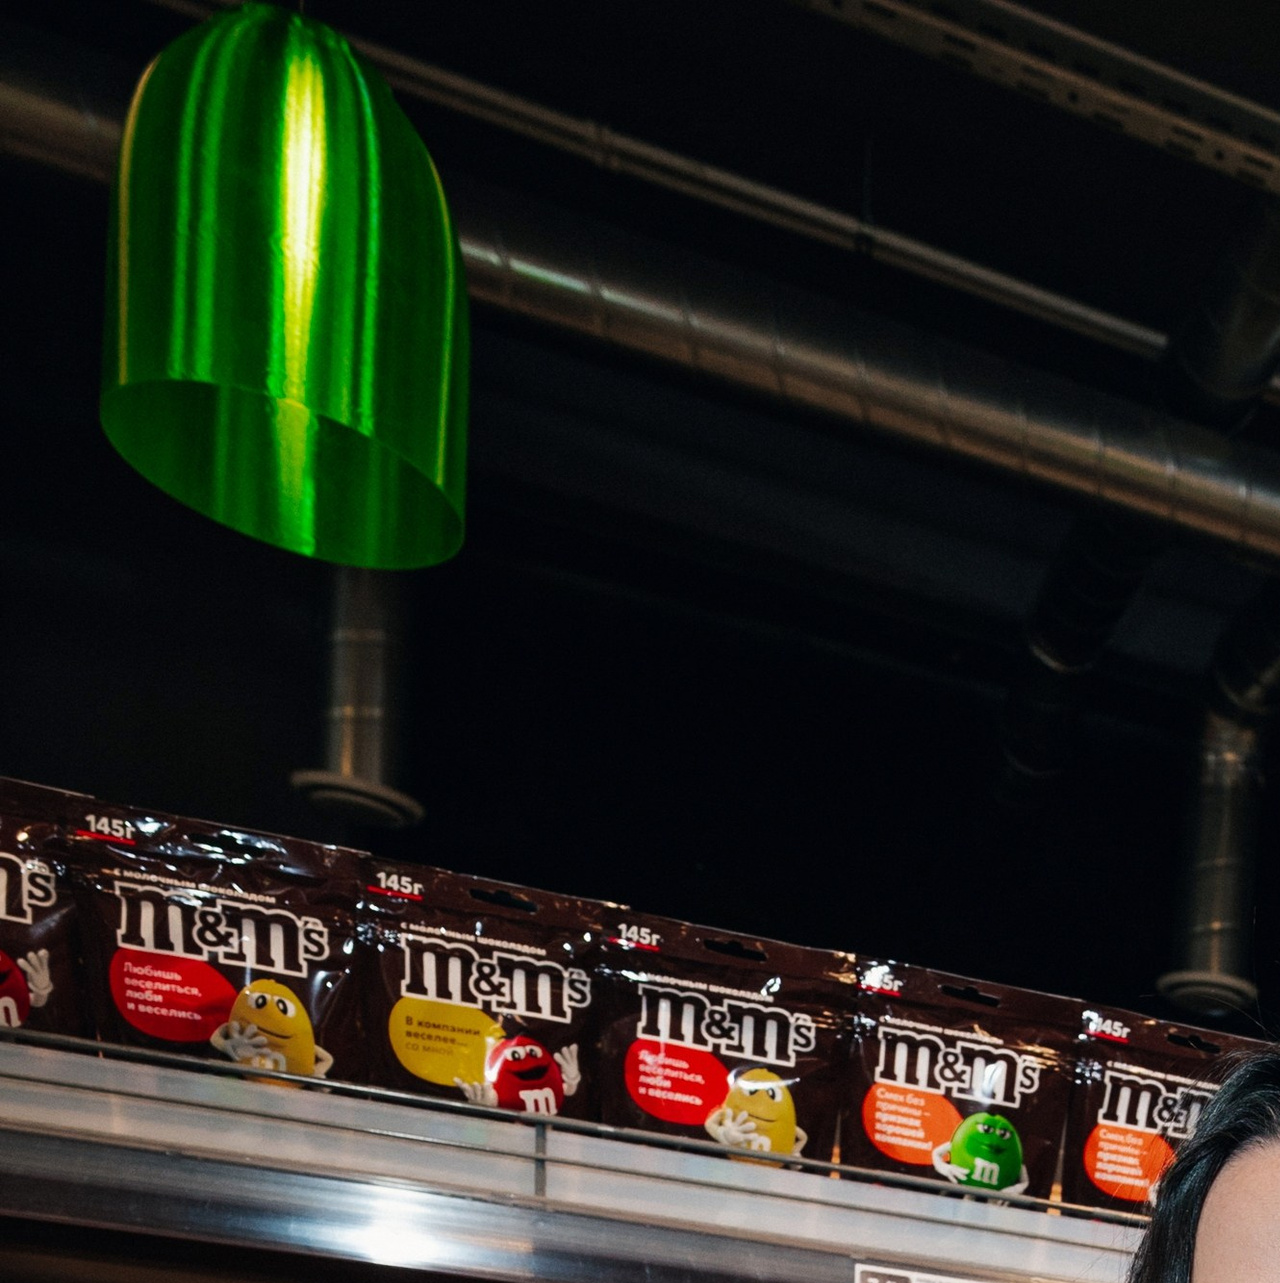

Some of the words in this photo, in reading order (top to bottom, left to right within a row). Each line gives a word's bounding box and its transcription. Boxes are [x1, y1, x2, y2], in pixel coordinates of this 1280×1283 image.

[376, 871, 423, 895] 145г
[115, 881, 329, 978] m&m's
[409, 923, 476, 942] молоным
[618, 923, 662, 946] 145г
[123, 962, 182, 981] Любишь
[401, 932, 591, 1024] m&m's
[125, 988, 164, 1003] люби
[138, 1002, 202, 1021] веселись
[637, 983, 817, 1067] m&m's
